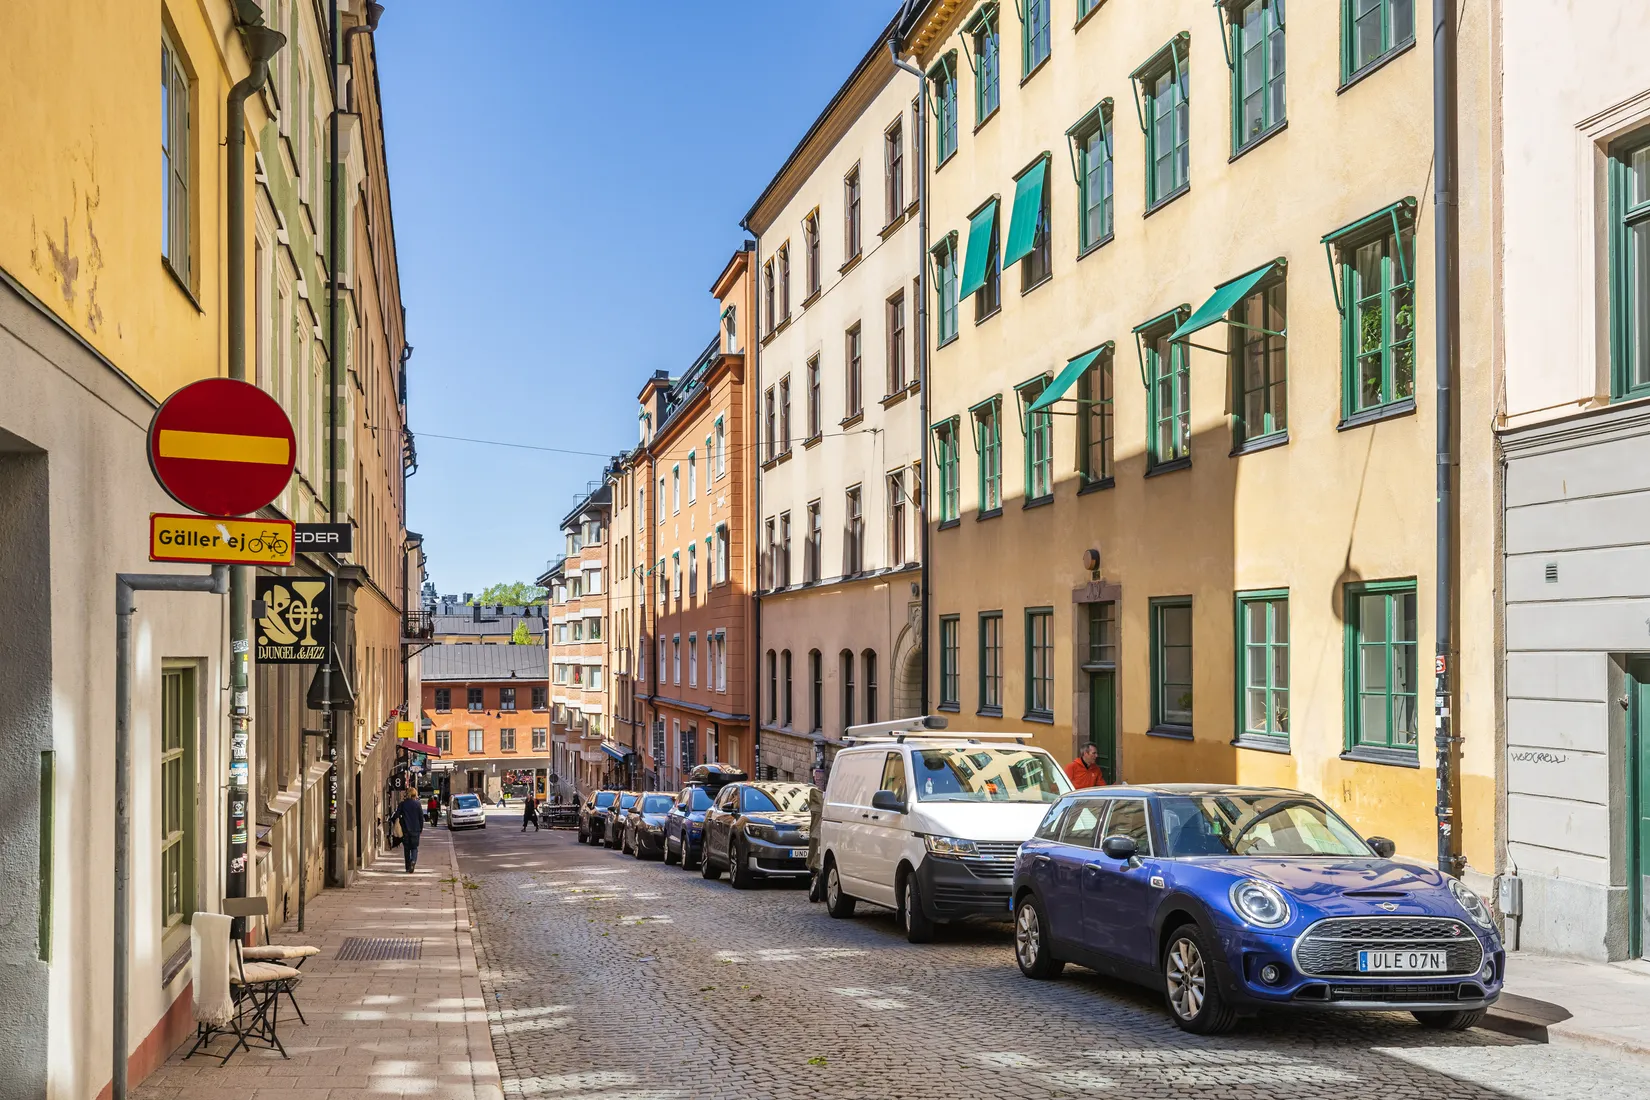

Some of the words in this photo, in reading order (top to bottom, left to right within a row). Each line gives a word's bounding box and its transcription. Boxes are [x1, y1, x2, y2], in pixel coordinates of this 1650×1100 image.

[158, 529, 222, 548] Gäller
[227, 533, 245, 552] ej
[258, 646, 296, 659] DJUNGEL
[395, 777, 401, 787] 8
[1373, 953, 1403, 969] ULE
